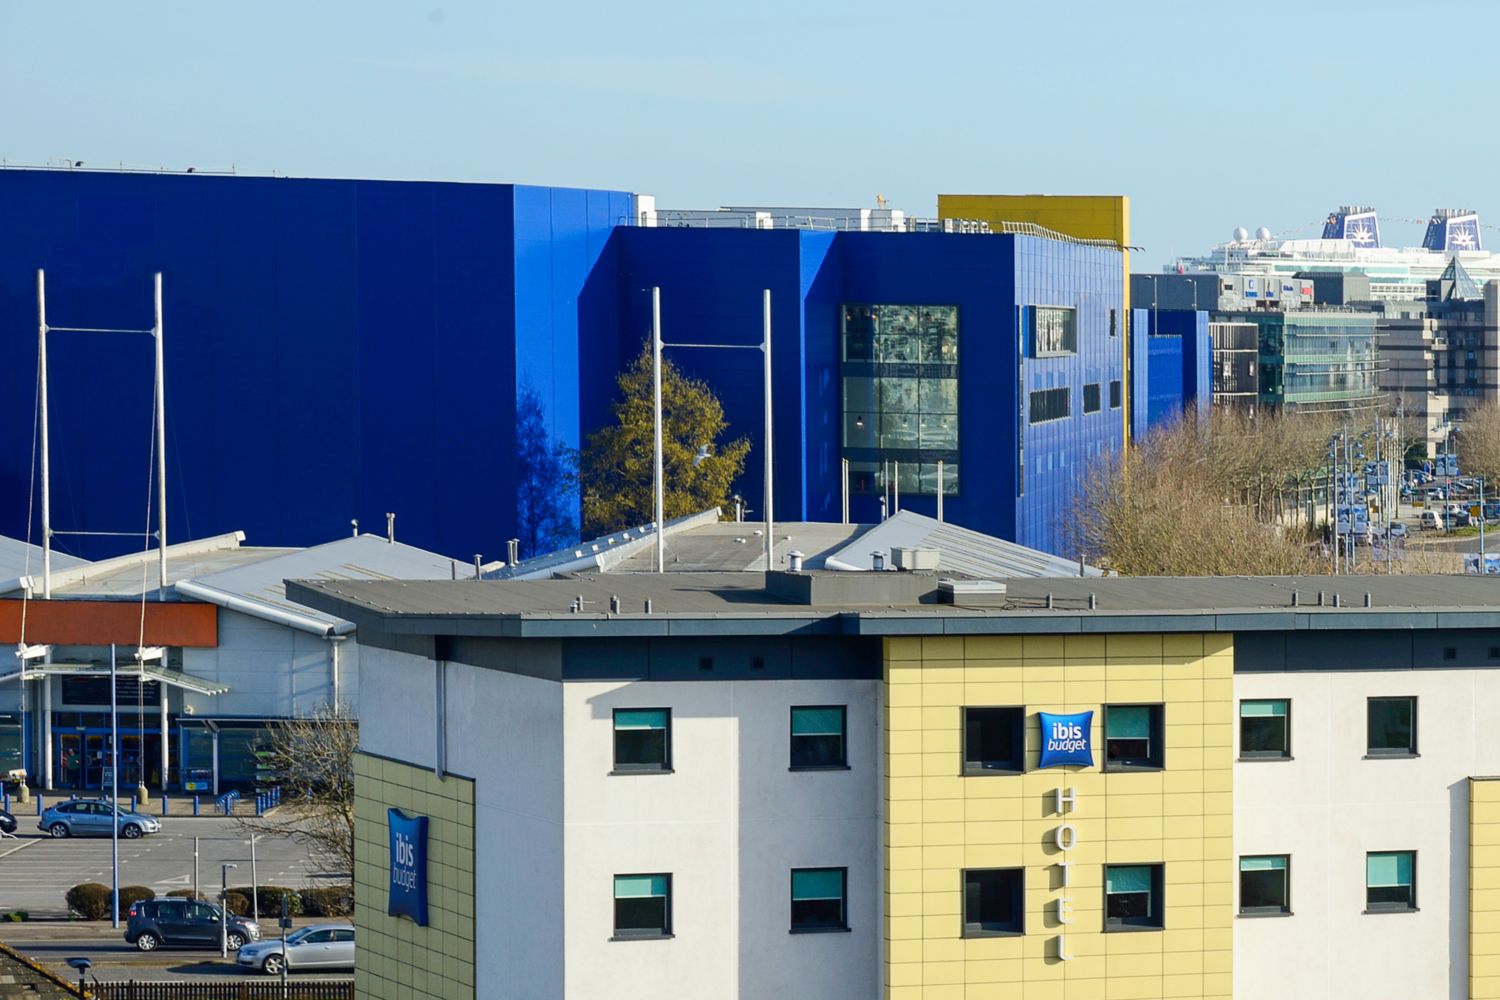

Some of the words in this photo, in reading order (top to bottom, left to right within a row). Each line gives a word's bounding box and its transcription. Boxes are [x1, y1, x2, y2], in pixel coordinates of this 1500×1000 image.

[1047, 738, 1087, 753] budget
[1051, 721, 1083, 740] ibis
[395, 832, 414, 867] ibis
[393, 863, 416, 893] budget
[1055, 788, 1076, 961] HOTEL
